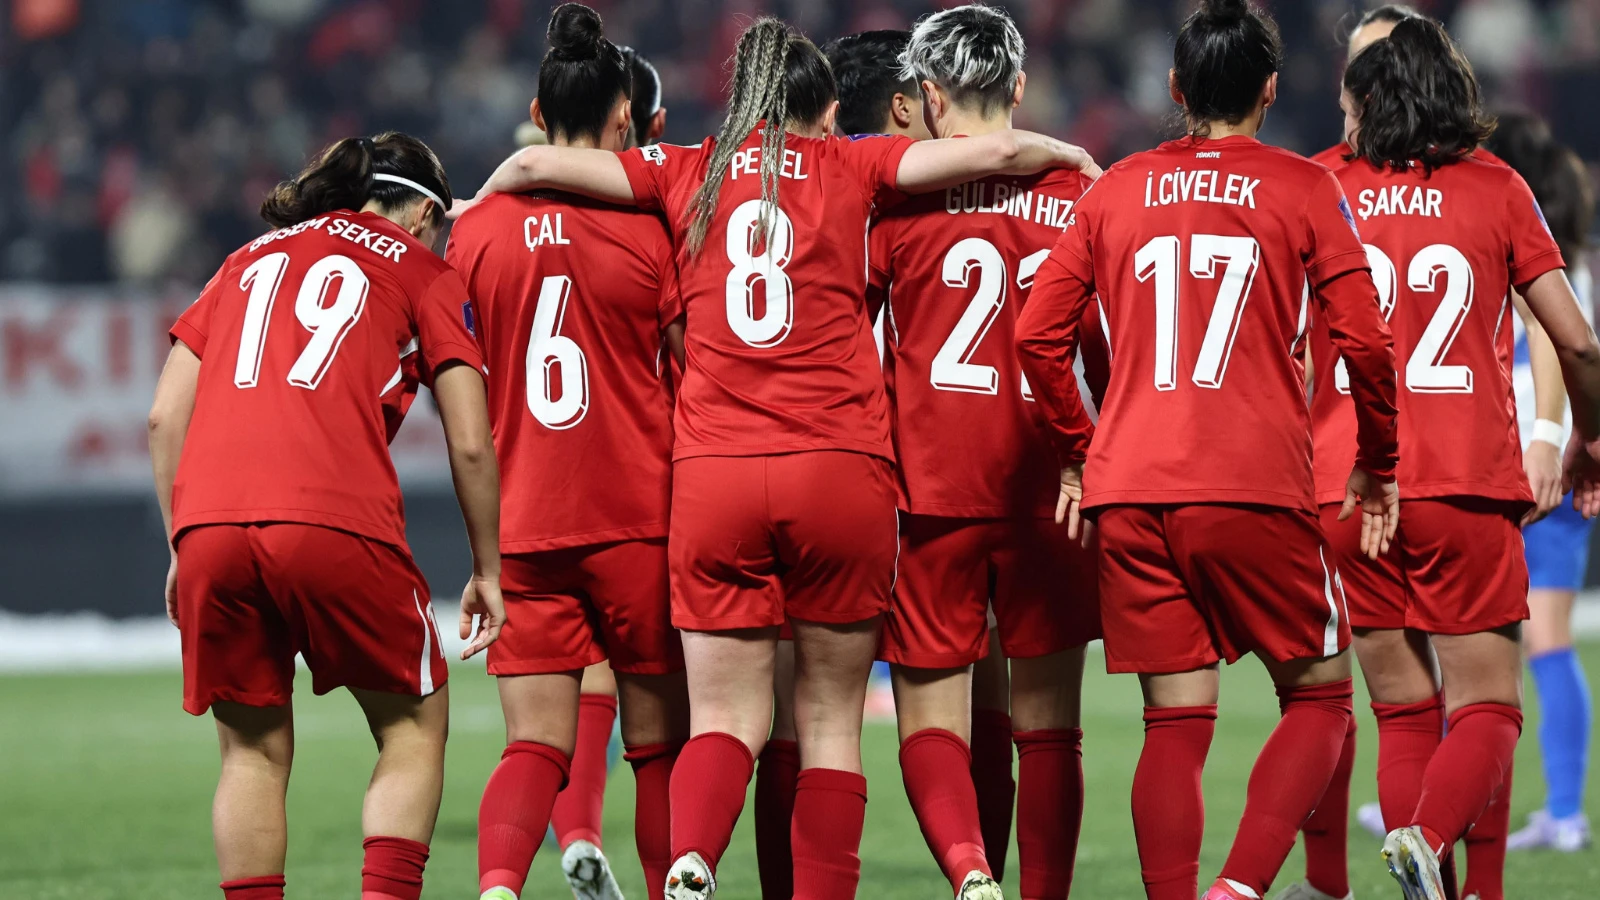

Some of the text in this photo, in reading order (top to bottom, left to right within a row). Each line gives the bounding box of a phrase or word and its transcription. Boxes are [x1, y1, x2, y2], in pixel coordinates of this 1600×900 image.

[327, 218, 408, 263] ŞEKER
[523, 212, 571, 252] ÇAL
[725, 199, 794, 348] 8
[1357, 185, 1443, 221] ŞAKAR
[234, 252, 370, 390] 19
[525, 275, 590, 430] 6
[930, 237, 1052, 402] 2
[1134, 233, 1261, 392] 17
